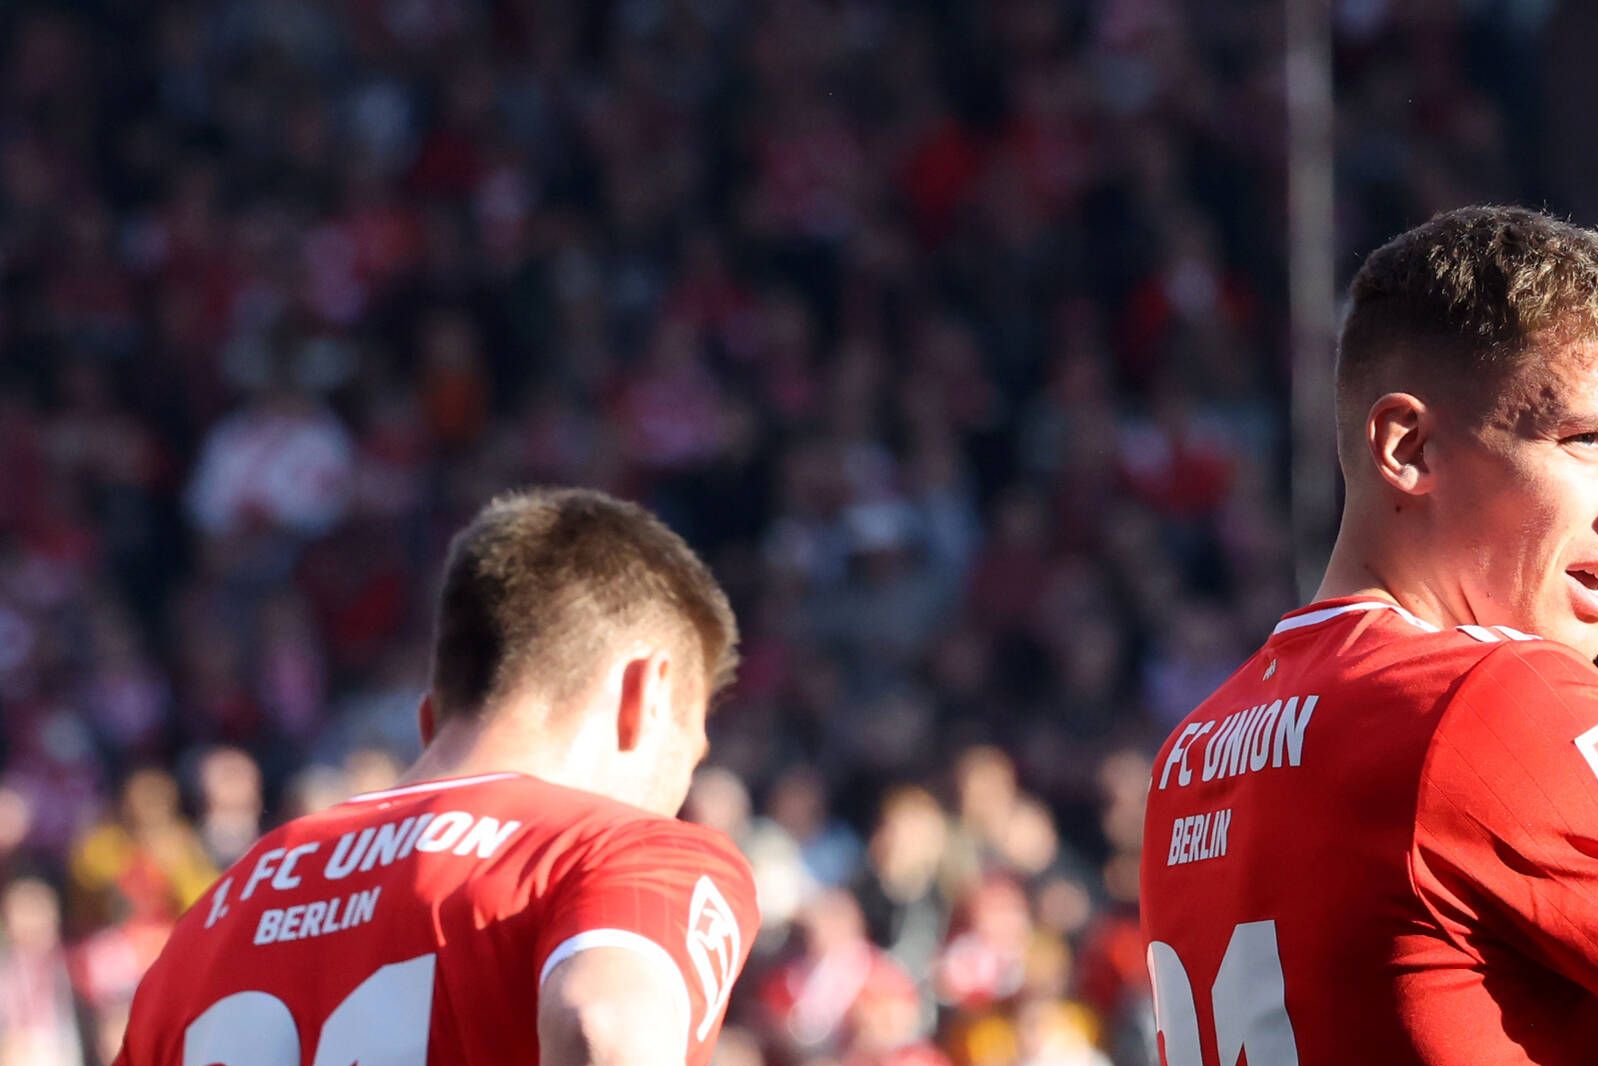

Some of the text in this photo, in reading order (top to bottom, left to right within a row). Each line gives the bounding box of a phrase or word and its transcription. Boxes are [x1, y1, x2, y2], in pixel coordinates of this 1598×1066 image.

[1158, 695, 1320, 790] FC UNION
[240, 841, 320, 901] FC
[323, 811, 522, 880] UNION
[1167, 808, 1232, 867] BERLIN
[253, 885, 382, 946] BERLIN
